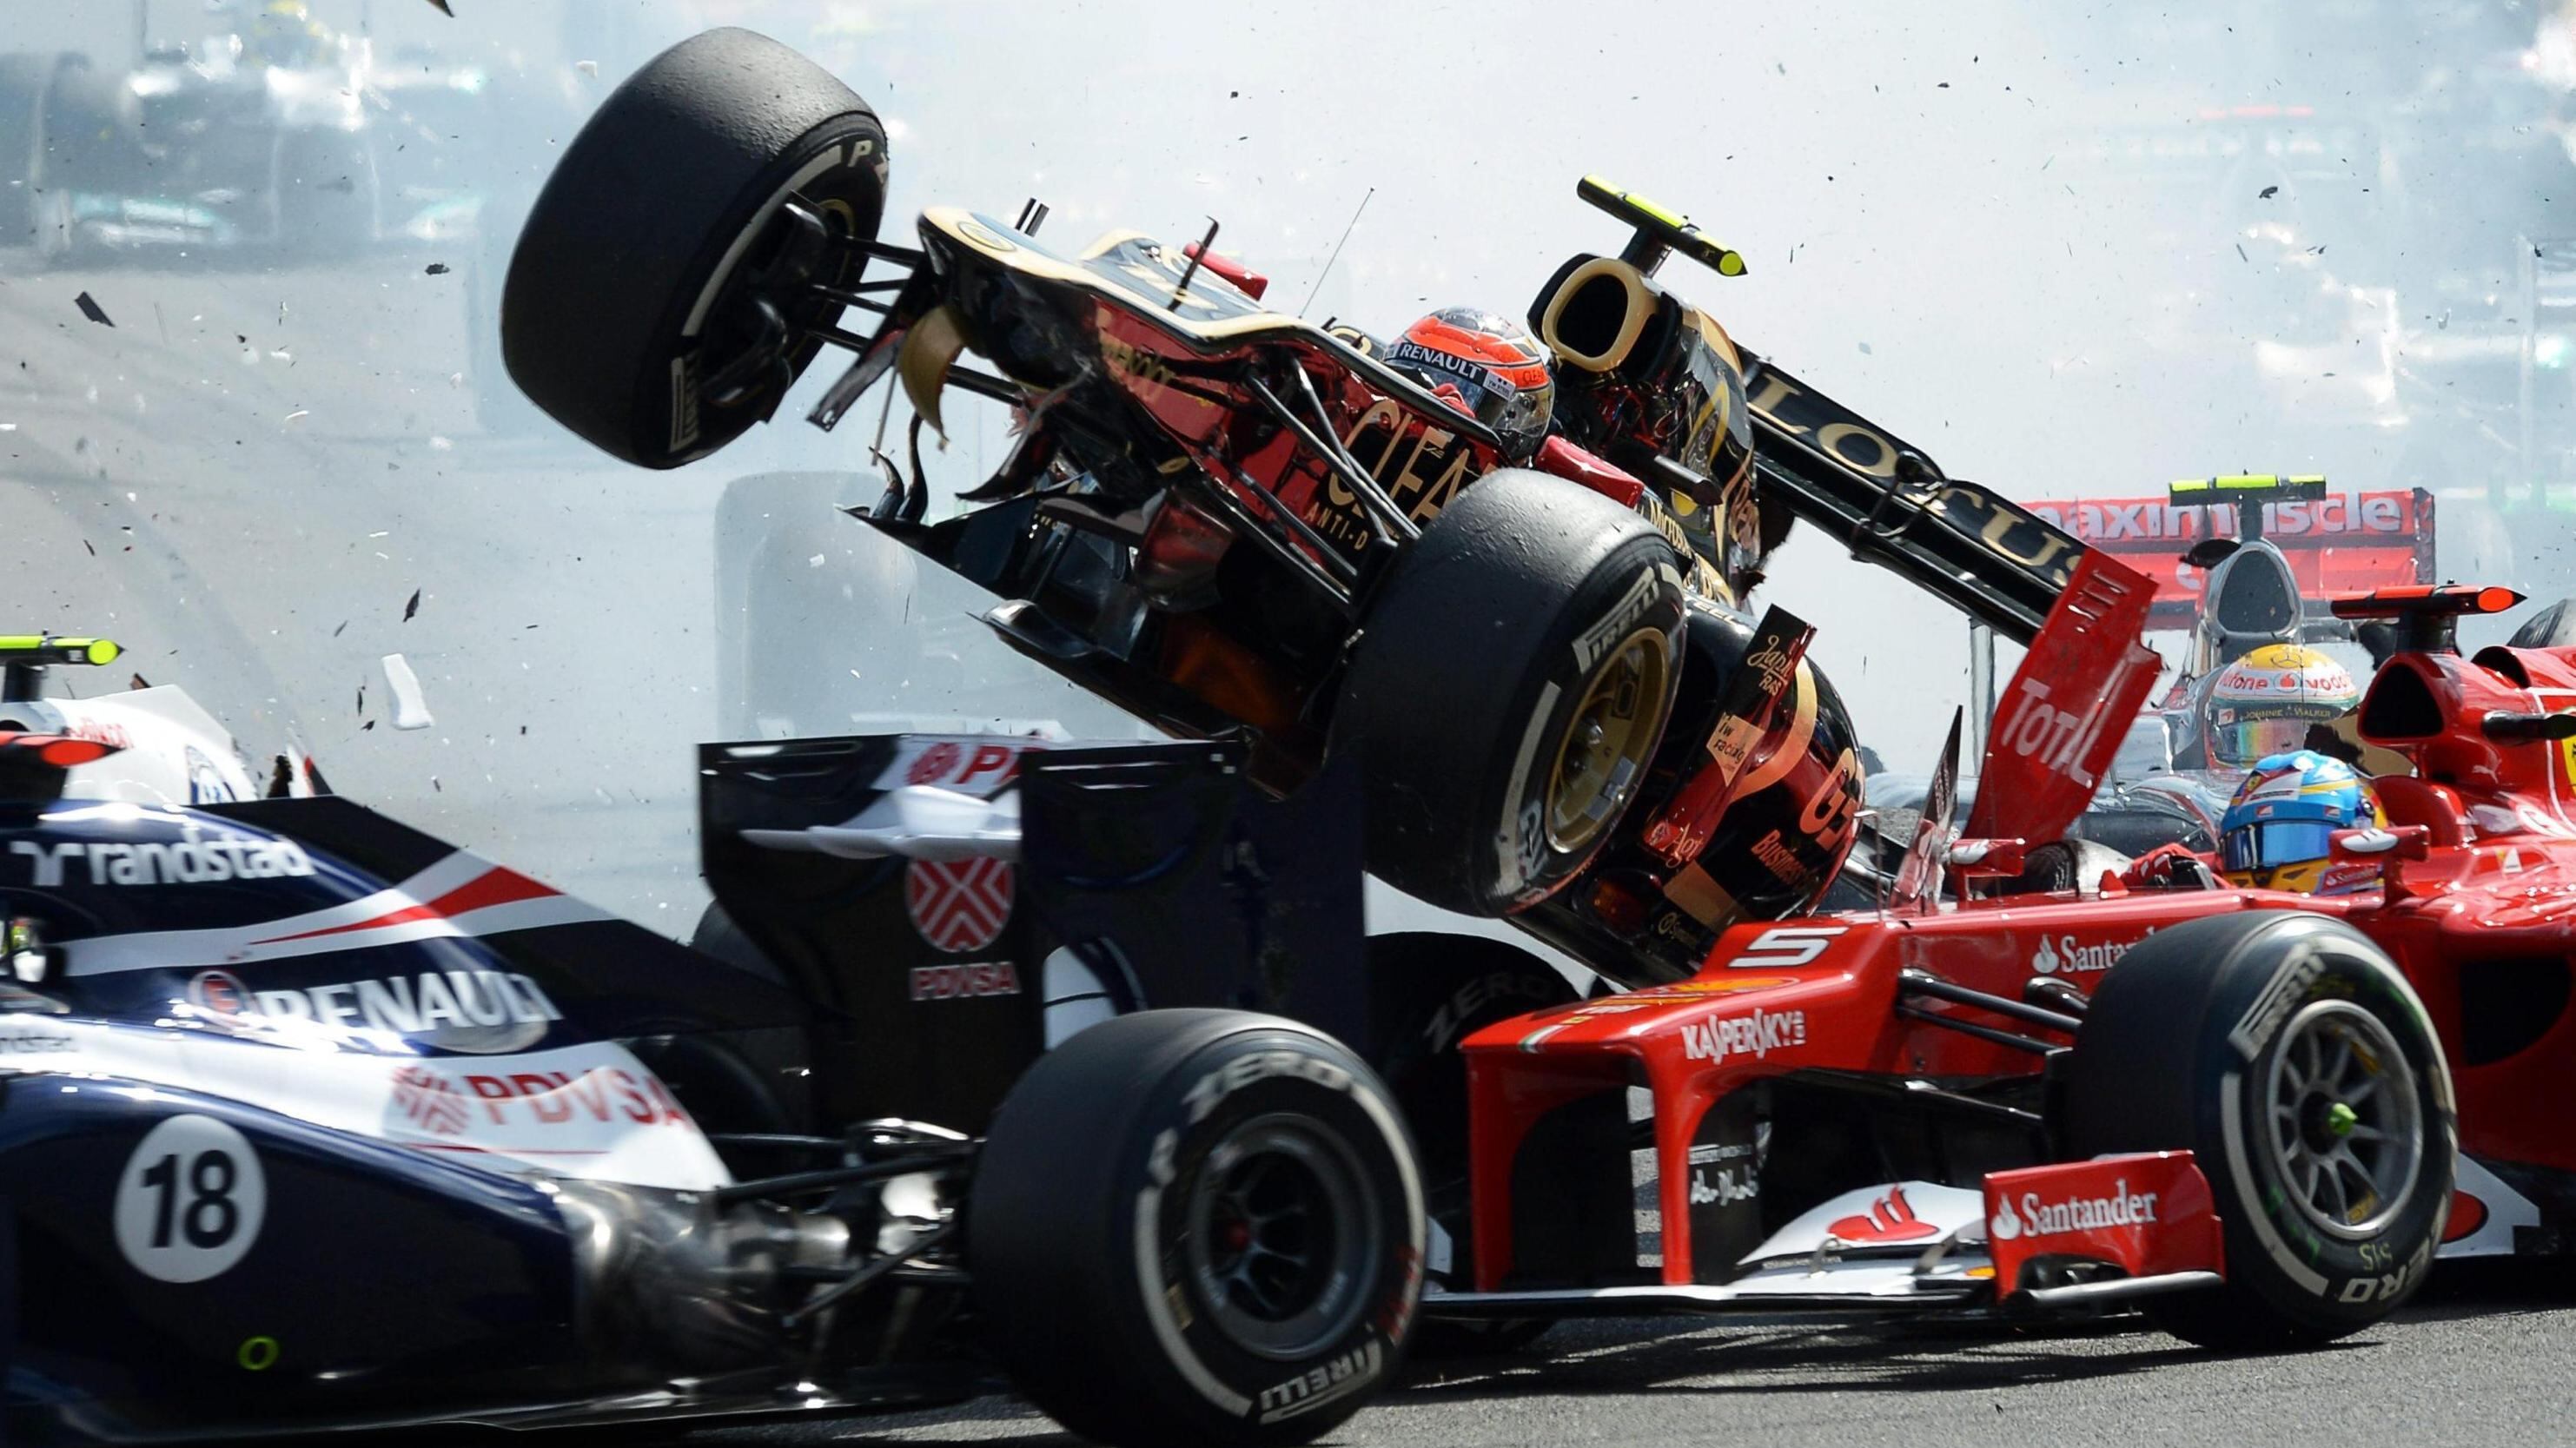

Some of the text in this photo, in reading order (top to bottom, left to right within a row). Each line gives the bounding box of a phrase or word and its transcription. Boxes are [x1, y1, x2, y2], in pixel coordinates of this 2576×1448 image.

[1399, 343, 1482, 380] RENAULT
[89, 823, 318, 886] randstad
[1728, 929, 1849, 969] 5
[1681, 1008, 1792, 1065] KASPERSKY
[141, 1149, 239, 1250] 18
[2022, 1178, 2157, 1238] Santander
